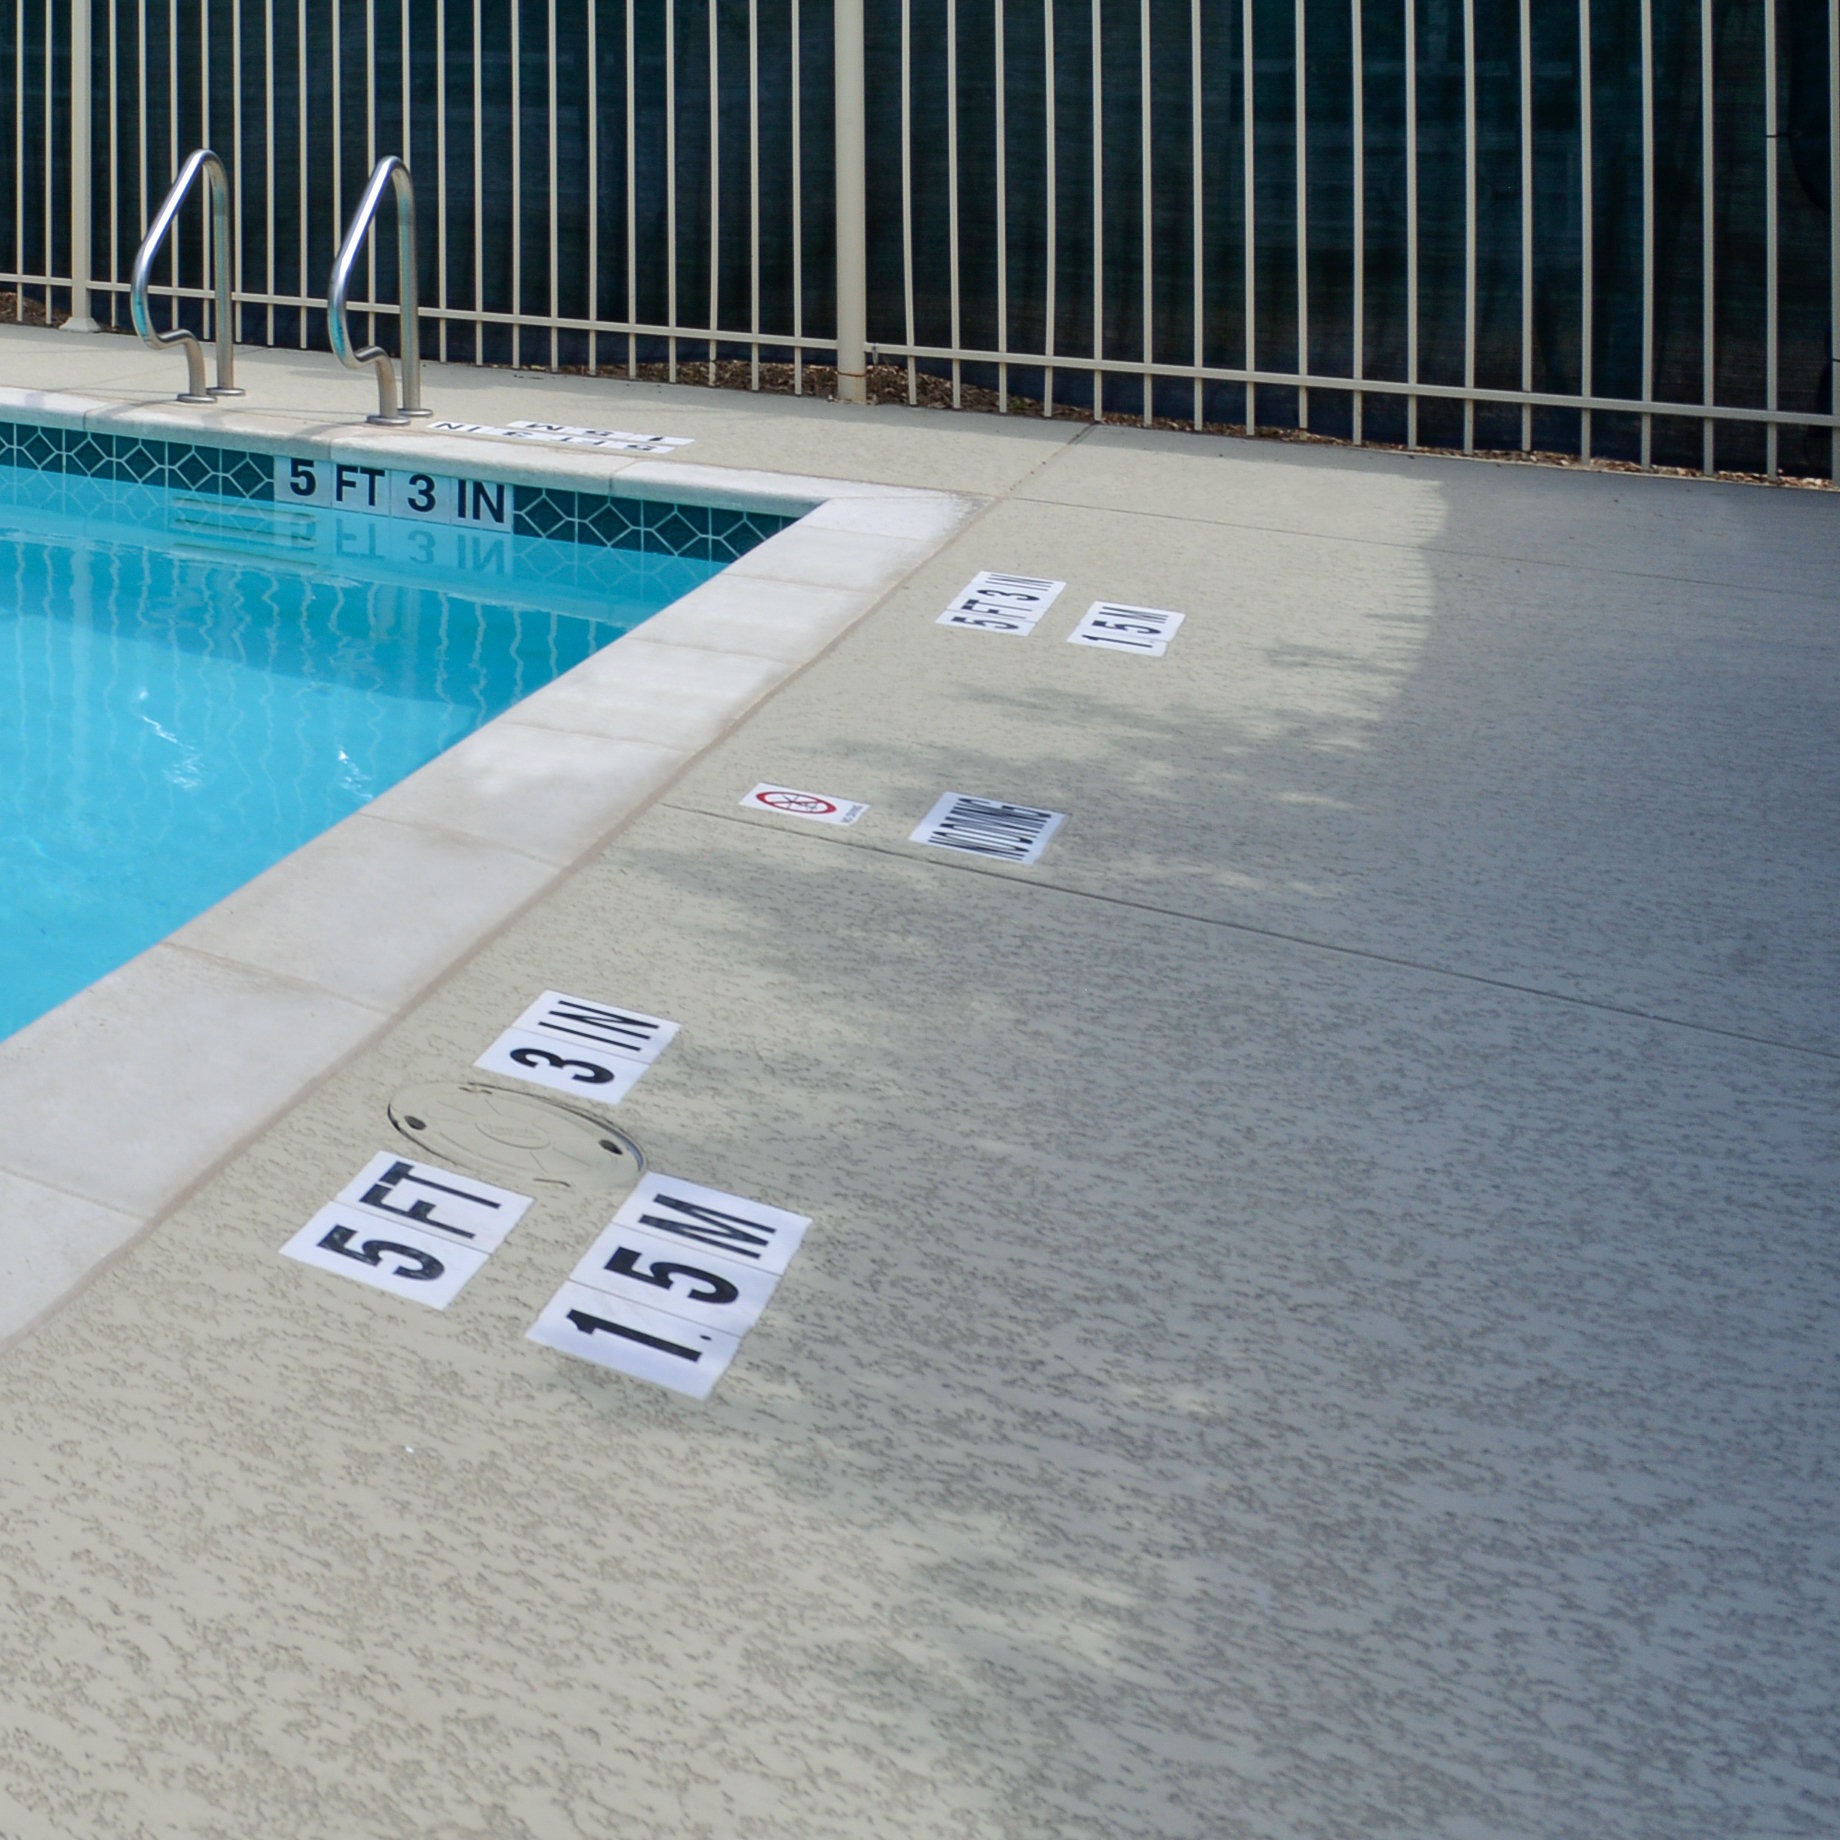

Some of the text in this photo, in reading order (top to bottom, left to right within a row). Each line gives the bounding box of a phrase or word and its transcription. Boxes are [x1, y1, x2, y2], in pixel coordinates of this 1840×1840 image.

[290, 458, 504, 523] 5 FT 3 IN
[951, 574, 1054, 630] 5 FT 3 IN
[927, 831, 1029, 861] NO
[538, 1000, 659, 1051] IN
[510, 1047, 614, 1084] 3
[359, 1161, 501, 1239] FT
[317, 1224, 445, 1281] 5
